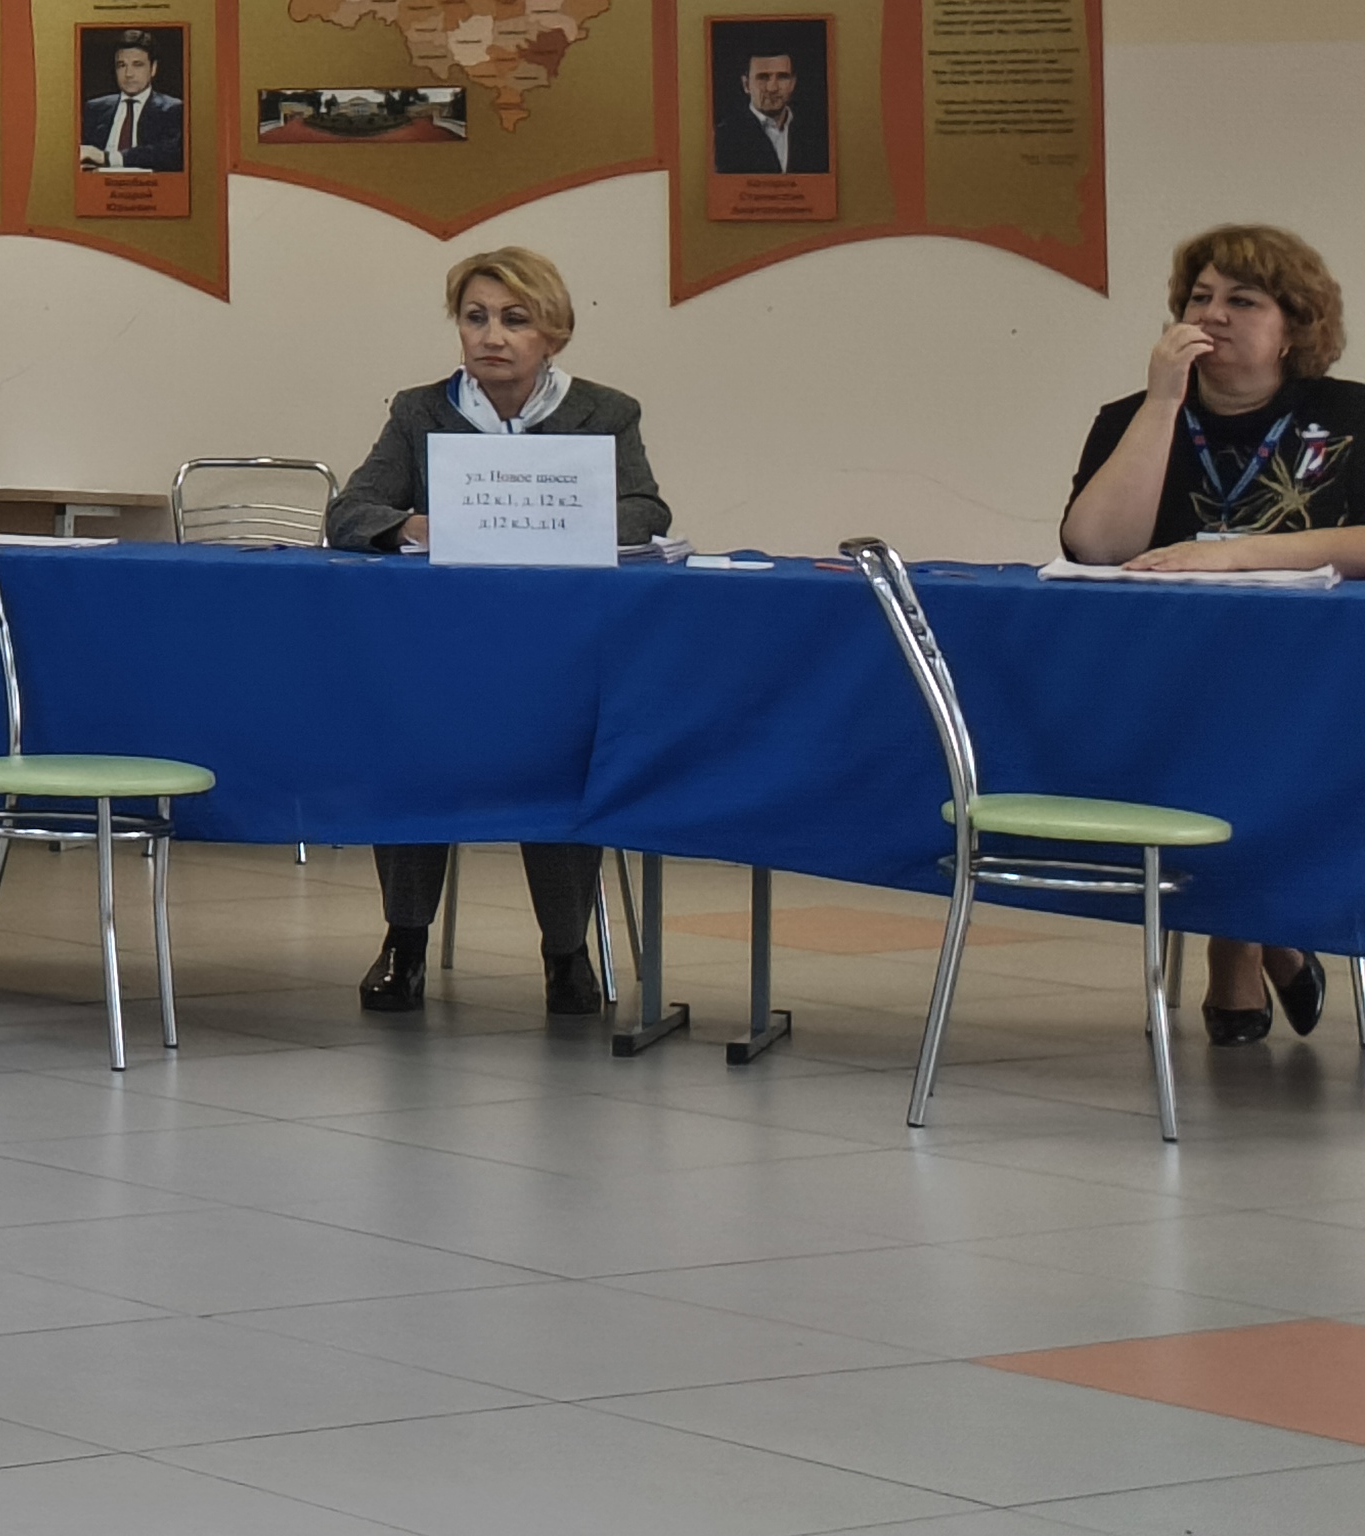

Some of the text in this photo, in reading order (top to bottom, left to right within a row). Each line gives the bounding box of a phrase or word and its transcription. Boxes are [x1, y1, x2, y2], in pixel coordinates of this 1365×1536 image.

[465, 470, 578, 485] ул. Новое шоссе
